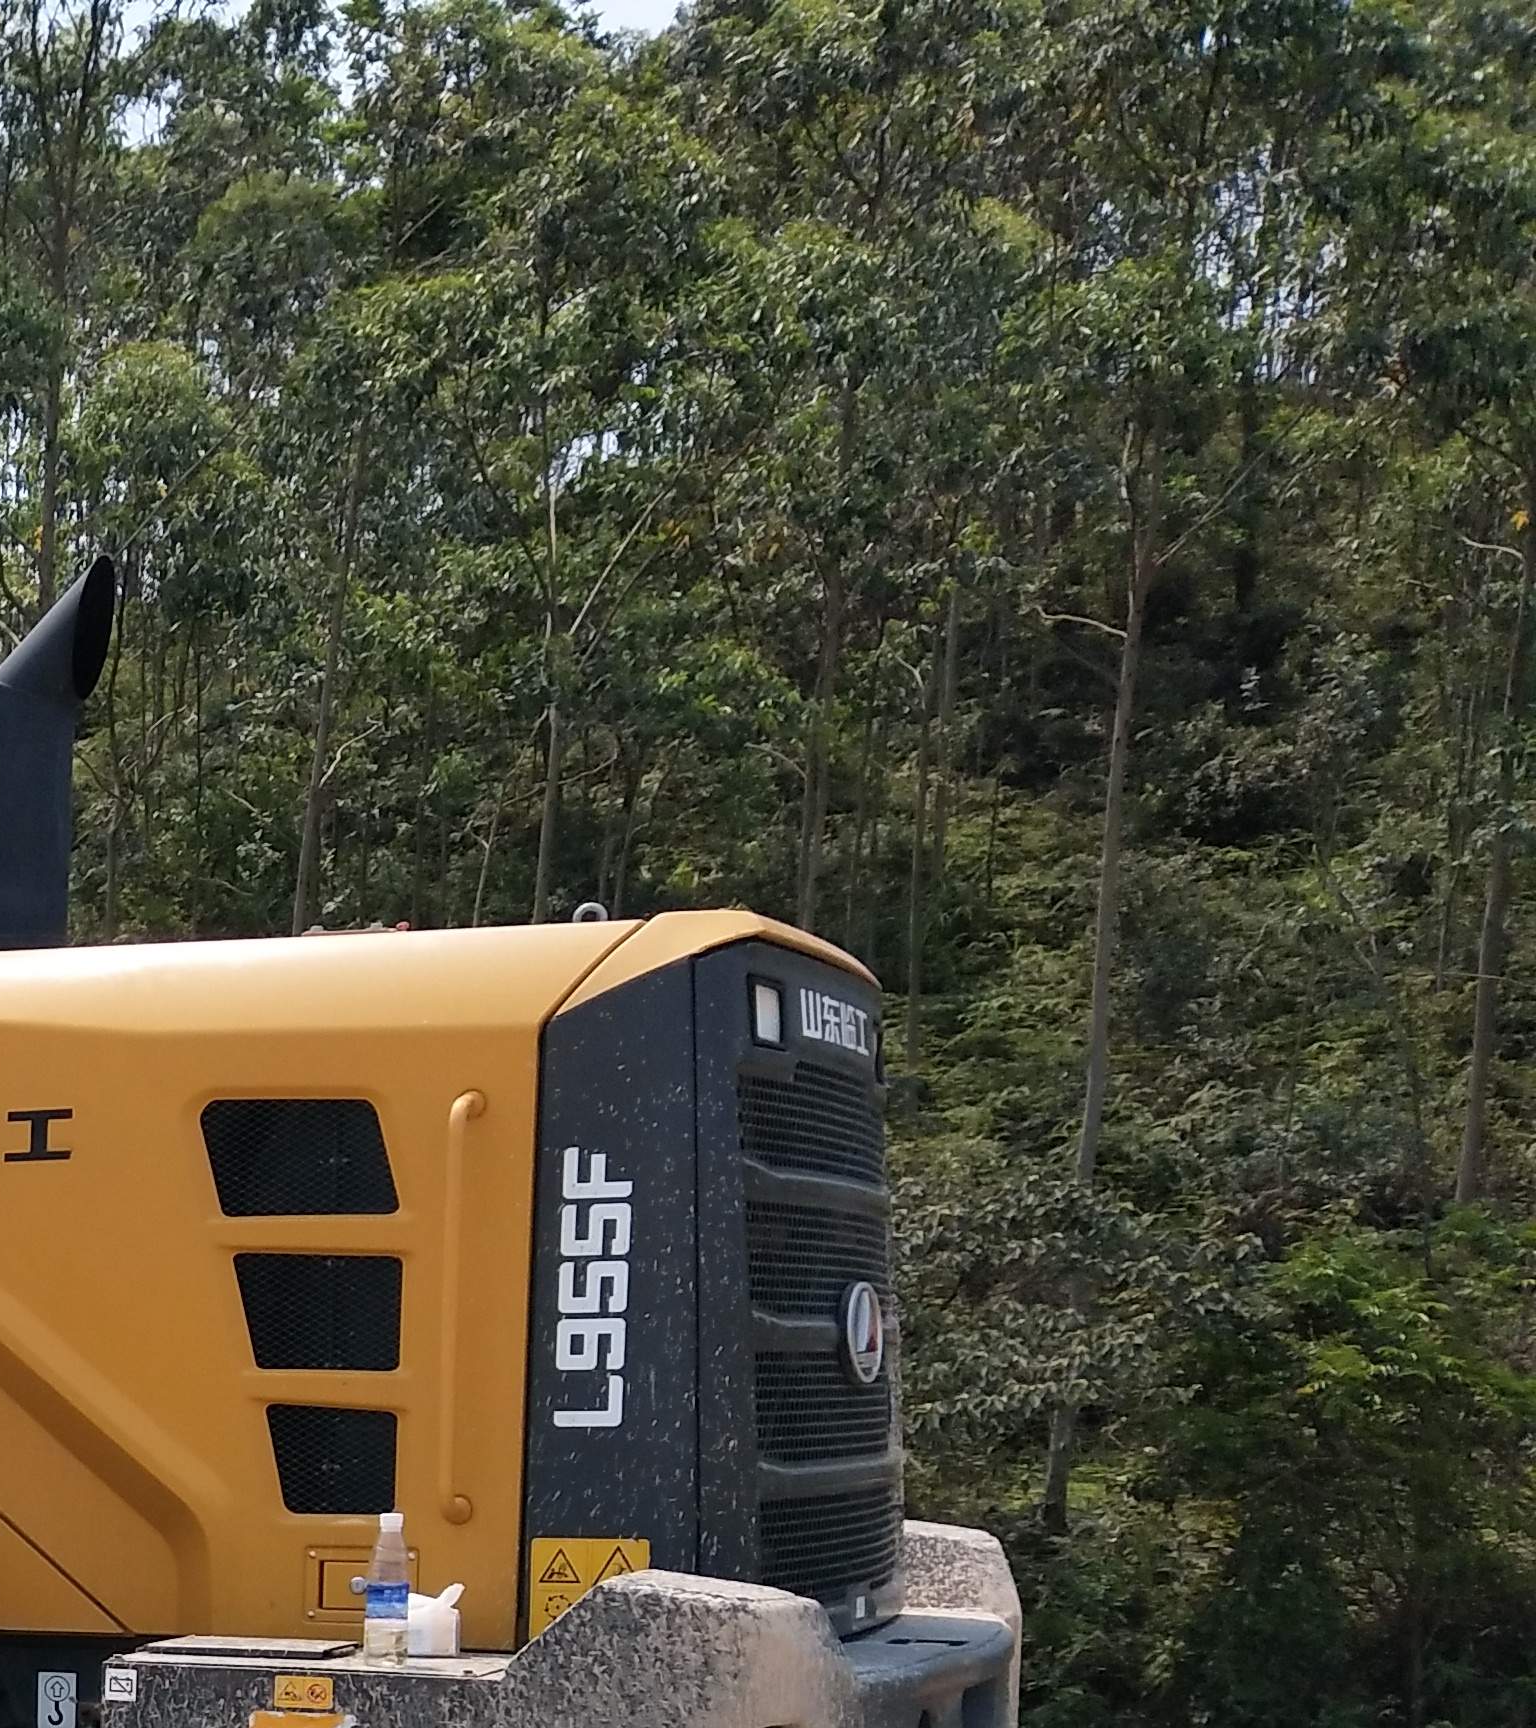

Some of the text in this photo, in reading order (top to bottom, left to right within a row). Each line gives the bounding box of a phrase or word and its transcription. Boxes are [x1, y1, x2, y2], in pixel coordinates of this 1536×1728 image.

[800, 988, 870, 1056] 山东临工
[553, 1146, 634, 1428] L955F
